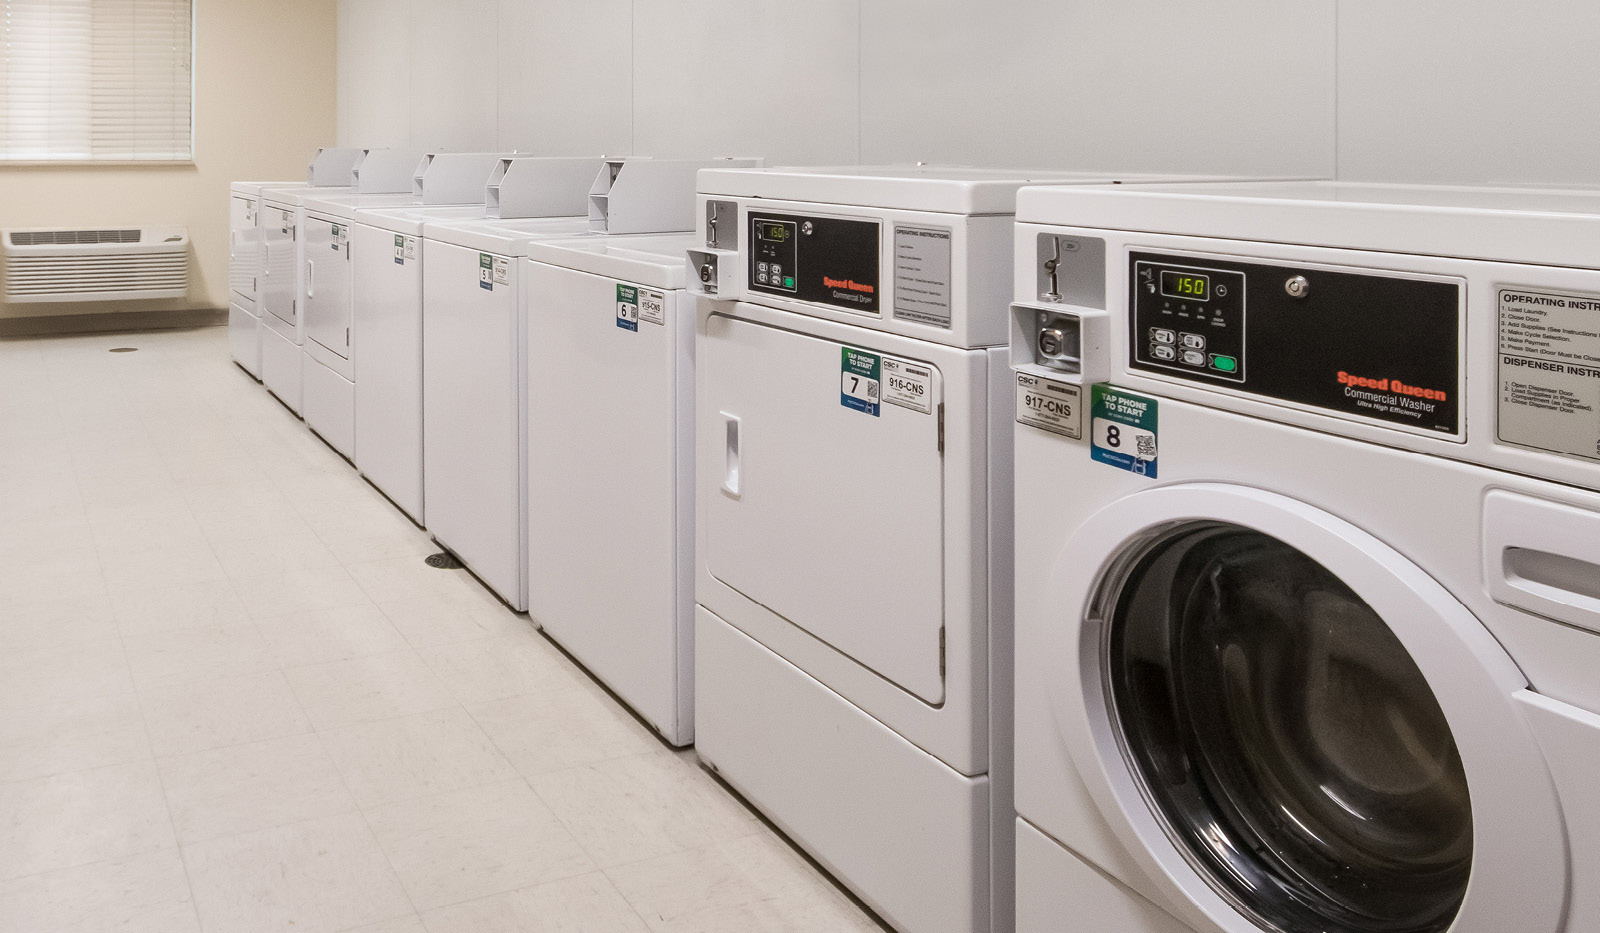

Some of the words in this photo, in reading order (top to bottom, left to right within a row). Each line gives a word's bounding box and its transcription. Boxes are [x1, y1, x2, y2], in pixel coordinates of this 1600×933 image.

[771, 228, 782, 238] 150
[920, 231, 950, 240] INSTRUCTIONS
[824, 276, 847, 288] Speed
[848, 280, 874, 293] Queen
[1178, 278, 1204, 294] 150
[832, 290, 858, 302] Commercial
[860, 294, 873, 304] Dryer
[1504, 294, 1565, 307] OPERATING
[621, 304, 627, 317] 6
[1521, 323, 1546, 331] Supplies
[1562, 328, 1597, 338] Instructions
[850, 358, 856, 366] TO
[857, 361, 872, 370] START
[858, 355, 874, 364] PHONE
[1504, 357, 1564, 372] DISPENSER
[851, 377, 859, 393] 7
[890, 377, 924, 395] 916-CNS
[1018, 376, 1034, 384] CSC
[1337, 371, 1388, 390] Speed
[1390, 380, 1446, 401] Queen
[1527, 390, 1551, 398] Supplies
[1528, 385, 1557, 394] Dispenser
[1025, 395, 1071, 416] 917-CNS
[1102, 393, 1117, 402] TAP
[1118, 397, 1147, 411] PHONE
[1344, 387, 1397, 405] Commercial
[1400, 397, 1435, 413] Washer
[1511, 393, 1550, 404] Compartment
[1529, 401, 1557, 410] Dispenser
[1105, 402, 1116, 410] TO
[1117, 405, 1144, 417] START
[1357, 400, 1372, 408] Ultra
[1373, 404, 1389, 412] High
[1390, 406, 1422, 418] Efficiency
[1106, 425, 1120, 447] 8
